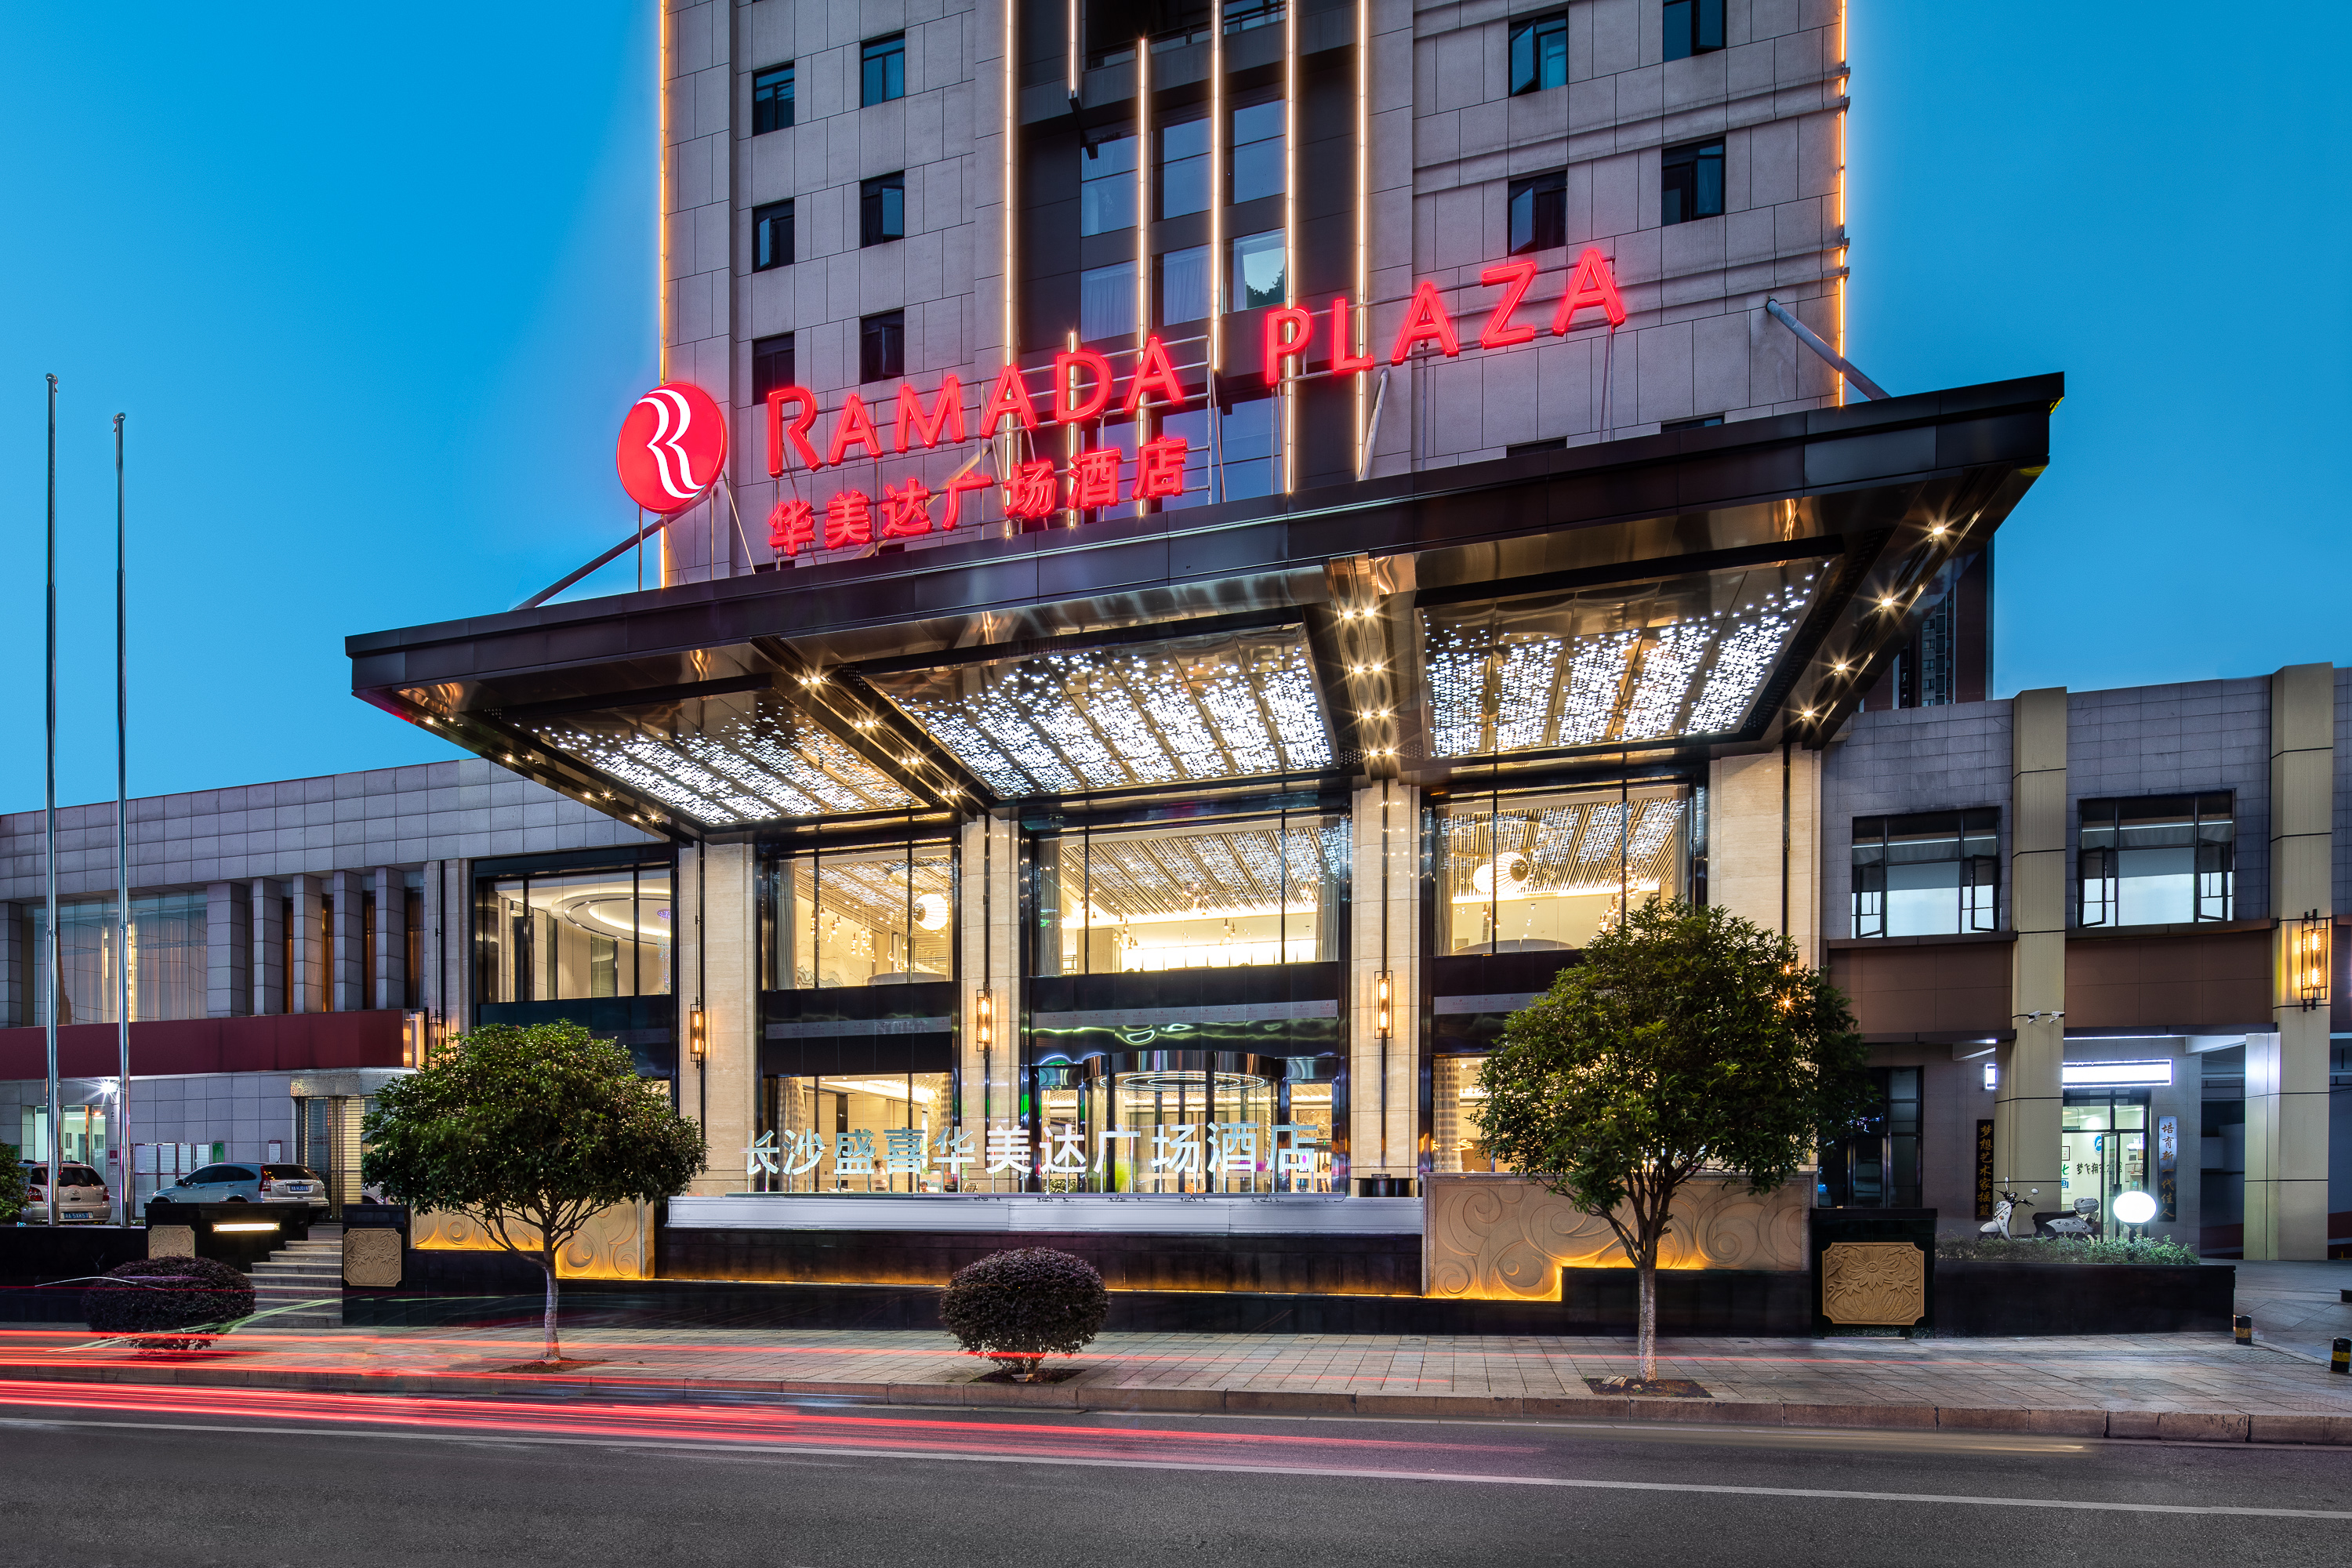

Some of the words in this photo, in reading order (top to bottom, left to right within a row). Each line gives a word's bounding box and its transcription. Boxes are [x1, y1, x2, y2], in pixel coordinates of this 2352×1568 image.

[768, 336, 1185, 477] RAMADA
[1265, 249, 1627, 386] PLAZA
[769, 437, 1188, 557] 华美达广场酒店
[746, 1120, 1319, 1175] 长沙盛喜华美达广场酒店
